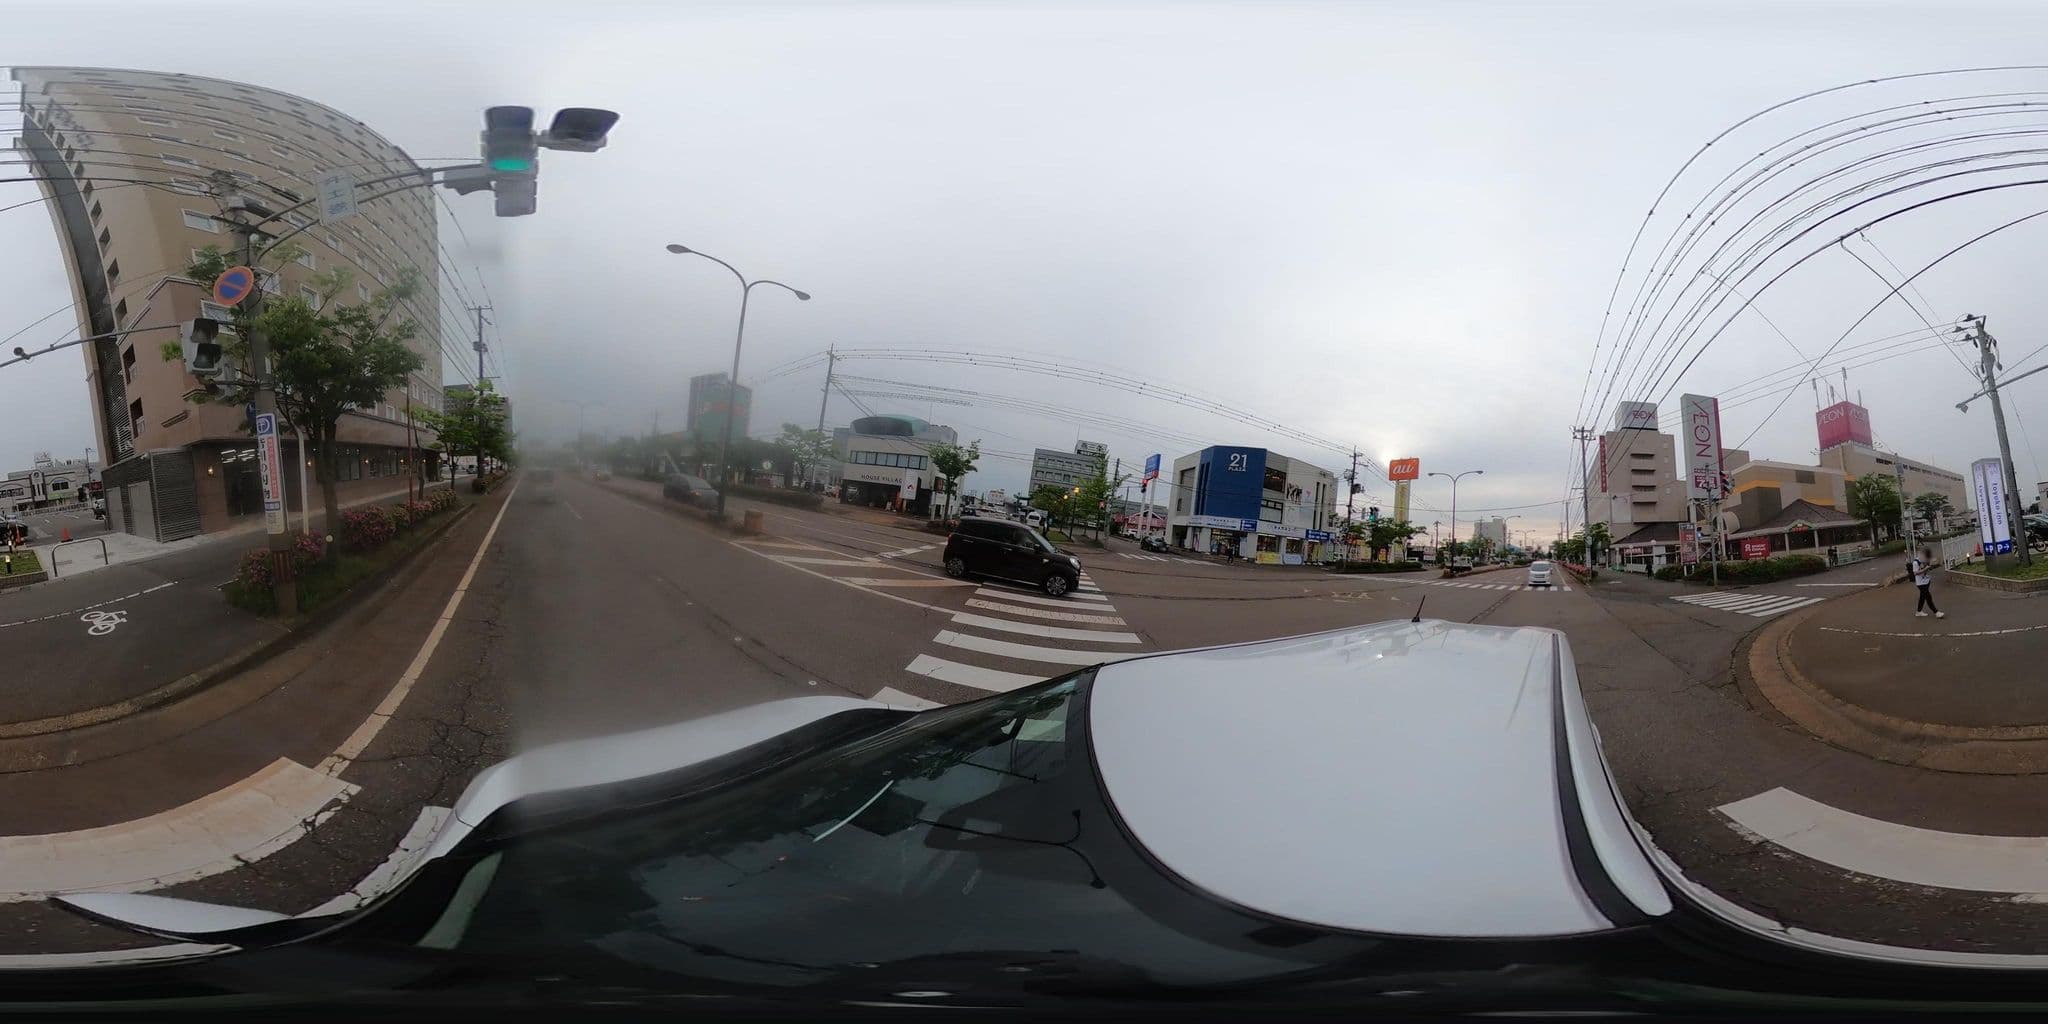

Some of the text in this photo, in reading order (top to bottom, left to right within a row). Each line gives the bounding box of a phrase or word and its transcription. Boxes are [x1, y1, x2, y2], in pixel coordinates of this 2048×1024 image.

[1229, 453, 1248, 468] 21
[1392, 464, 1414, 475] au
[861, 473, 880, 481] HOUSE
[1995, 512, 2003, 525] inn
[1997, 544, 2003, 553] P
